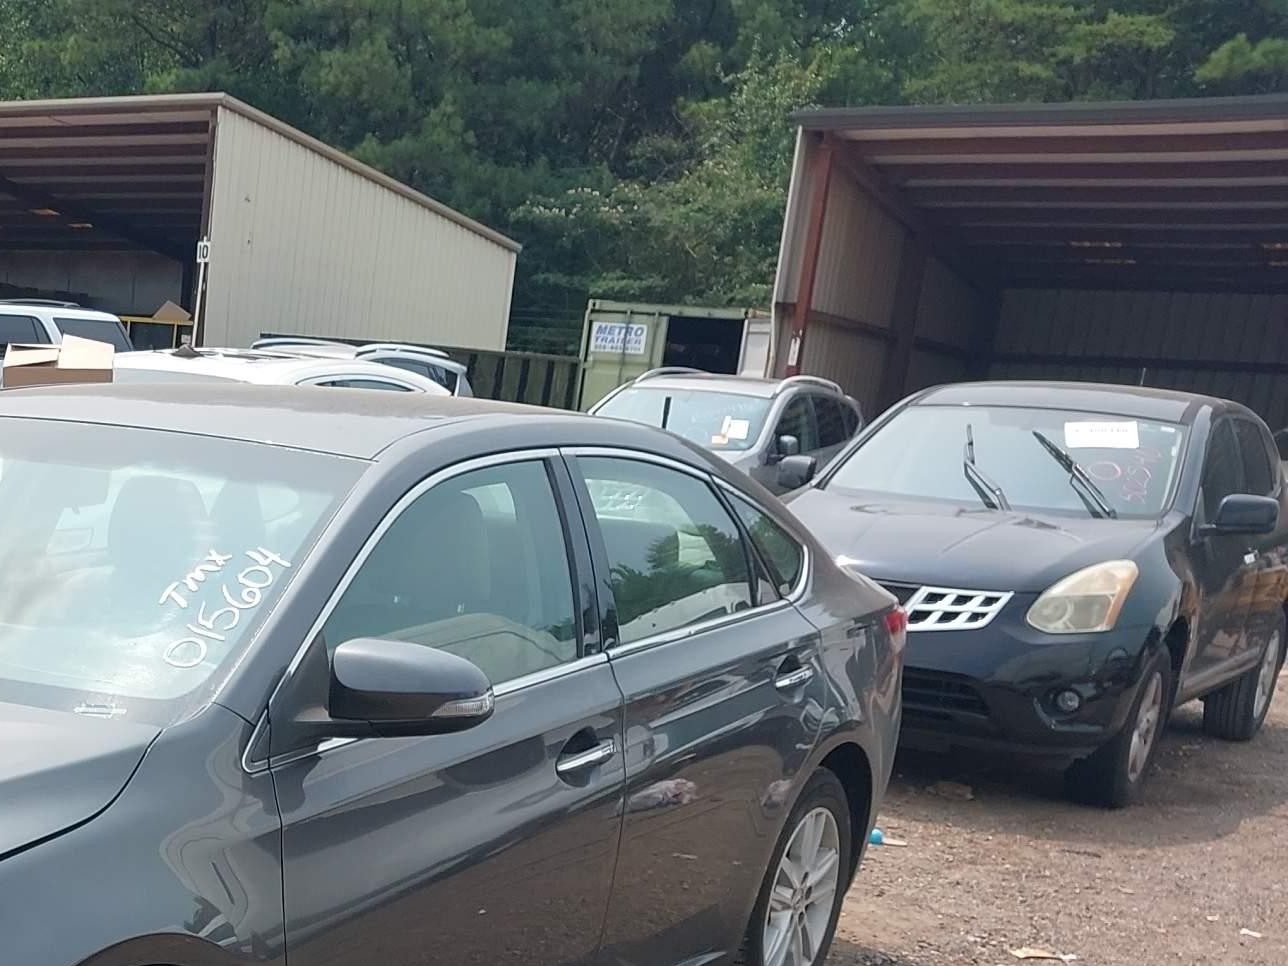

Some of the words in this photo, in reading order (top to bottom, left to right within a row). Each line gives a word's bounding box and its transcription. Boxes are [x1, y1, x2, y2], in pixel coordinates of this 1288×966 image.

[199, 244, 209, 260] 10
[595, 324, 645, 337] METRO
[163, 546, 292, 669] 015604
